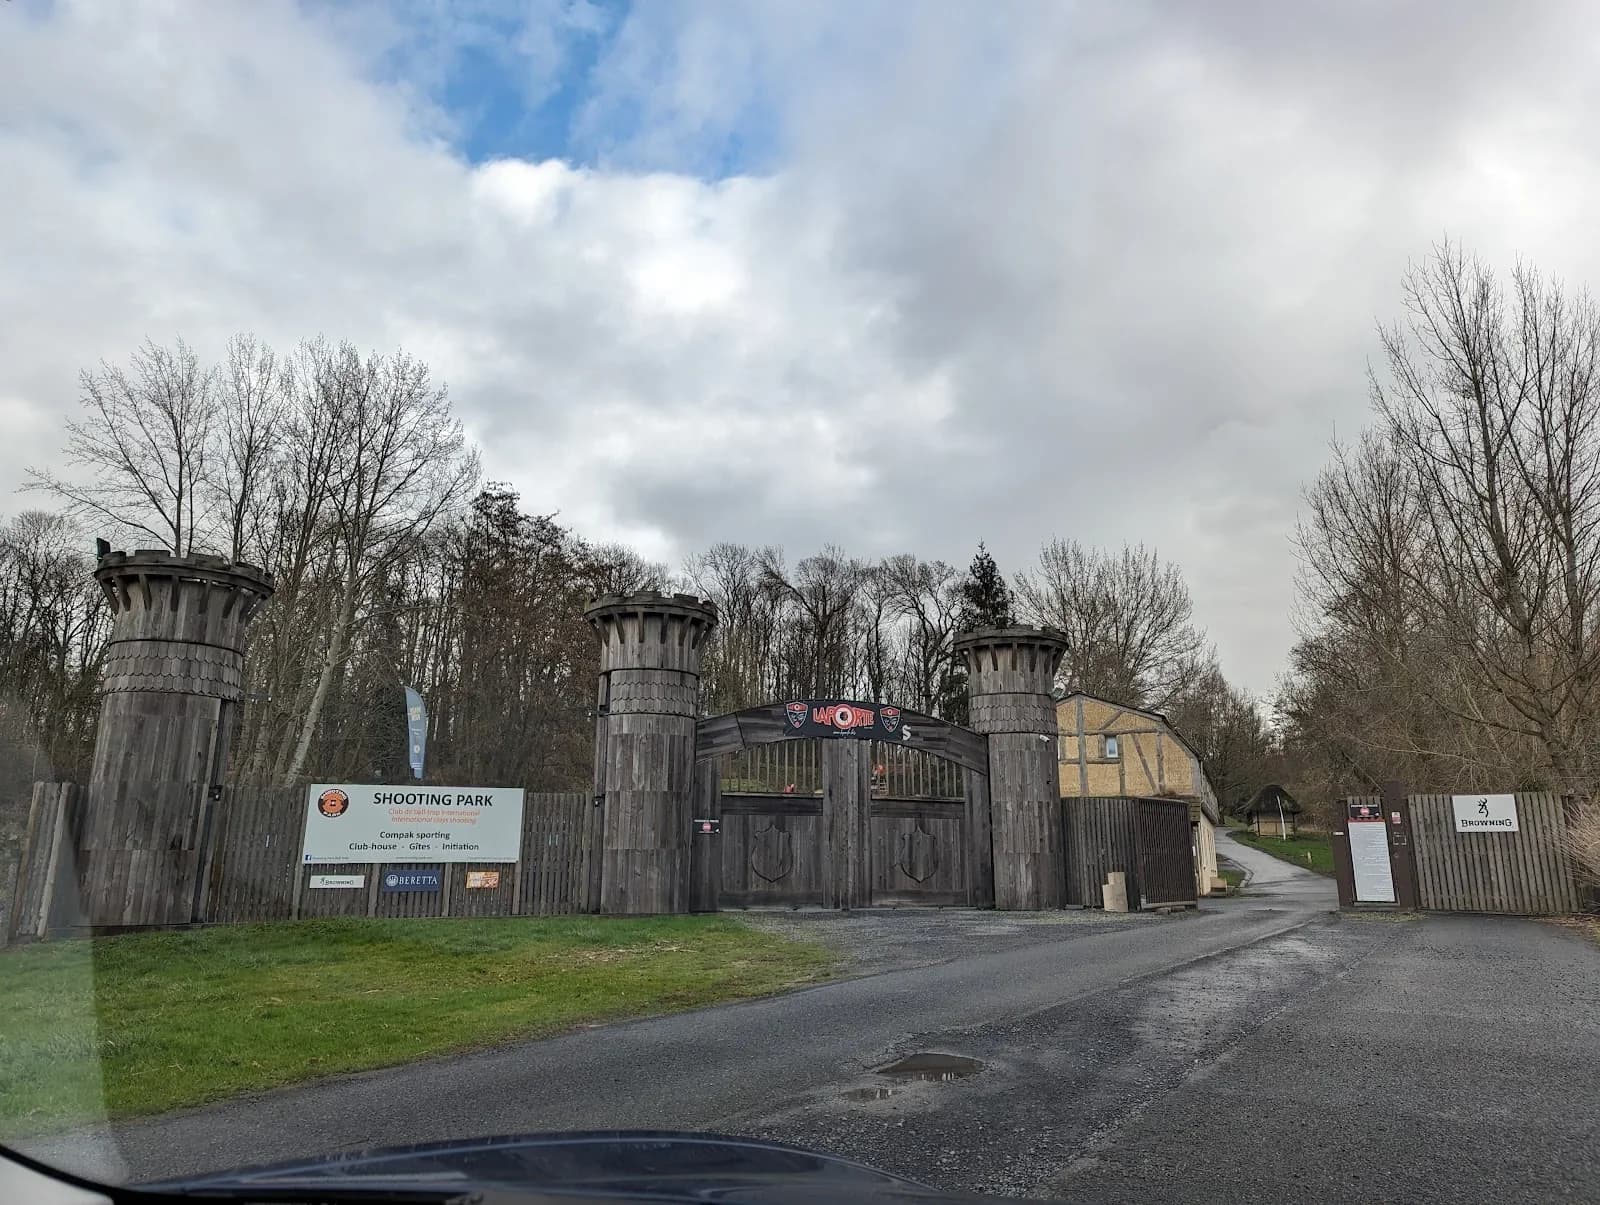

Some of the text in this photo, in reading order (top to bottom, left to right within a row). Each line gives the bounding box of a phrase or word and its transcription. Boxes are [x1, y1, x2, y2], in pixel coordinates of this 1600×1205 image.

[812, 703, 875, 730] LAPORTE
[373, 792, 493, 807] SHOOTING PARK
[1461, 818, 1512, 827] BROWNING
[379, 831, 450, 840] Compak sporting
[349, 842, 397, 851] Club-house
[409, 842, 431, 851] Gîtes
[442, 842, 479, 851] Initiation
[399, 875, 438, 885] BERETTA
